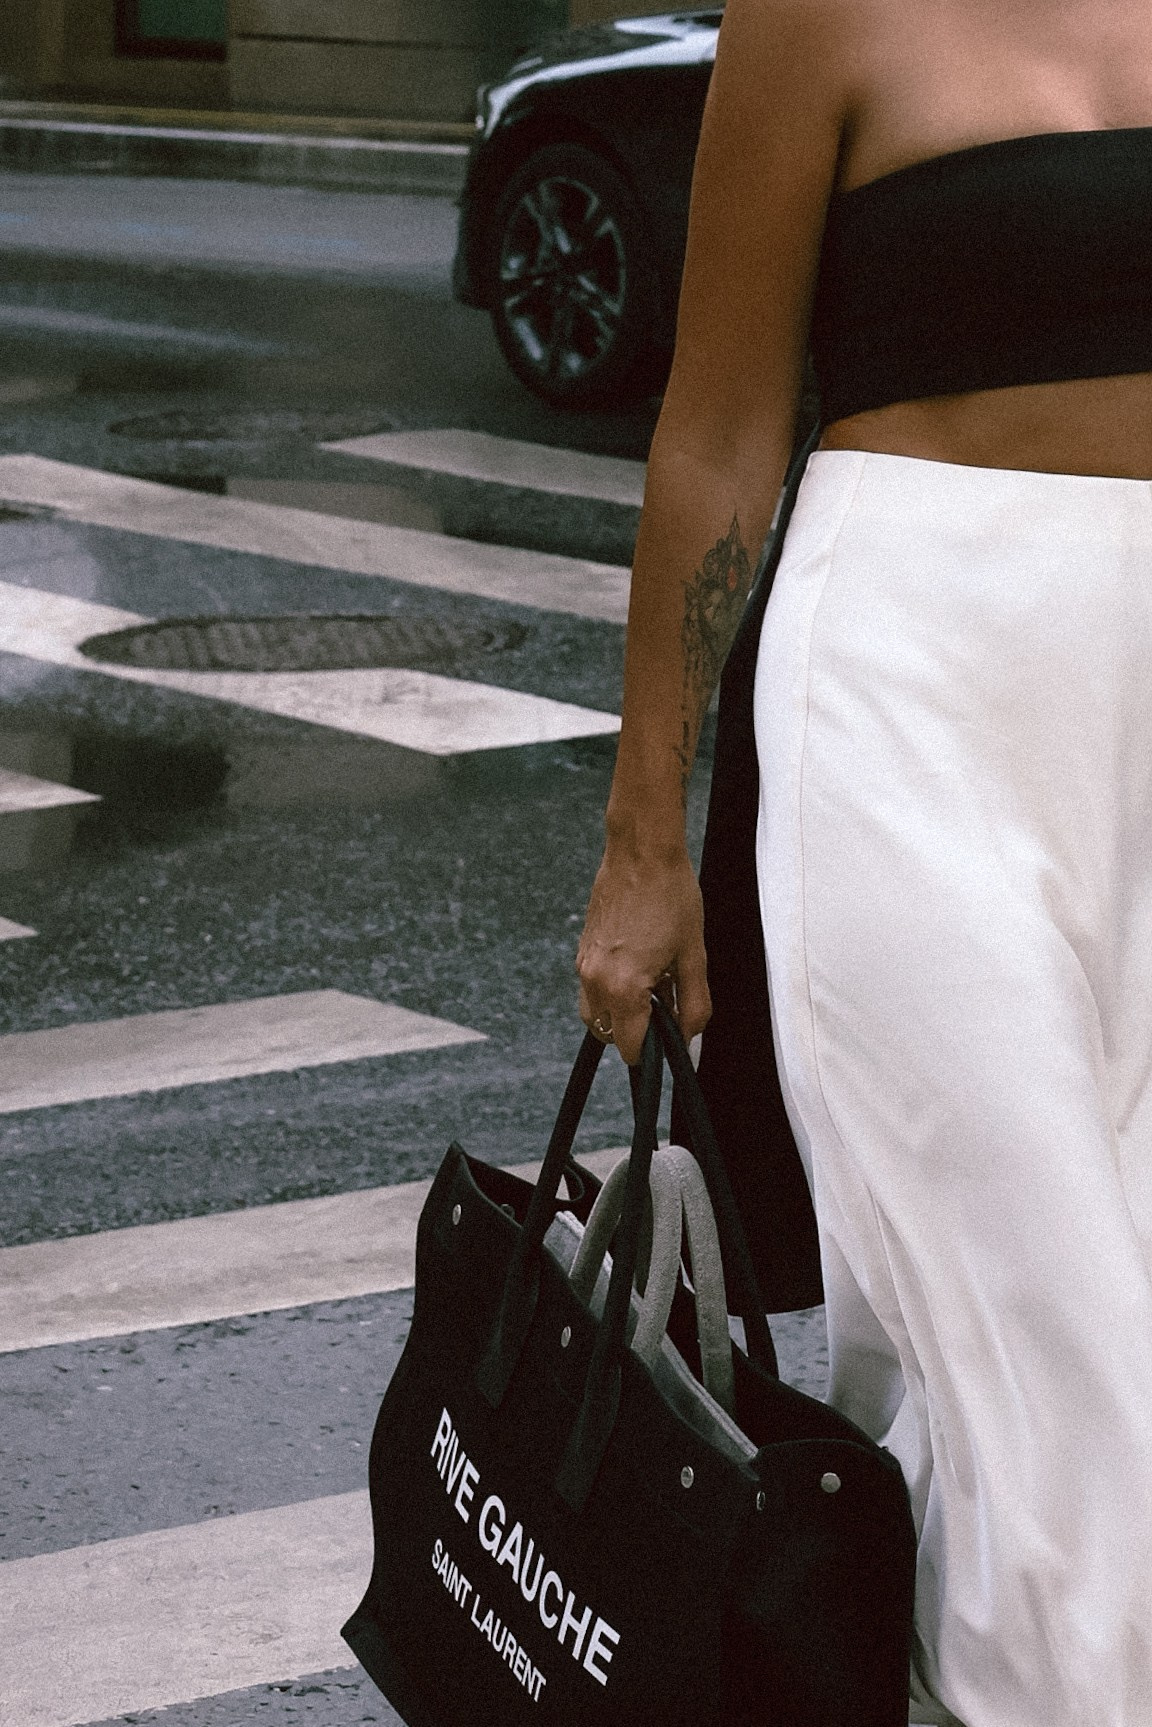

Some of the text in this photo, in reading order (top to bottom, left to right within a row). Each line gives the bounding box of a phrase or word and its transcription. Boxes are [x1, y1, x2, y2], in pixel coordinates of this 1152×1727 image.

[430, 1407, 621, 1687] RIVE GAUCHE
[431, 1538, 547, 1703] SAINT LAURENT
